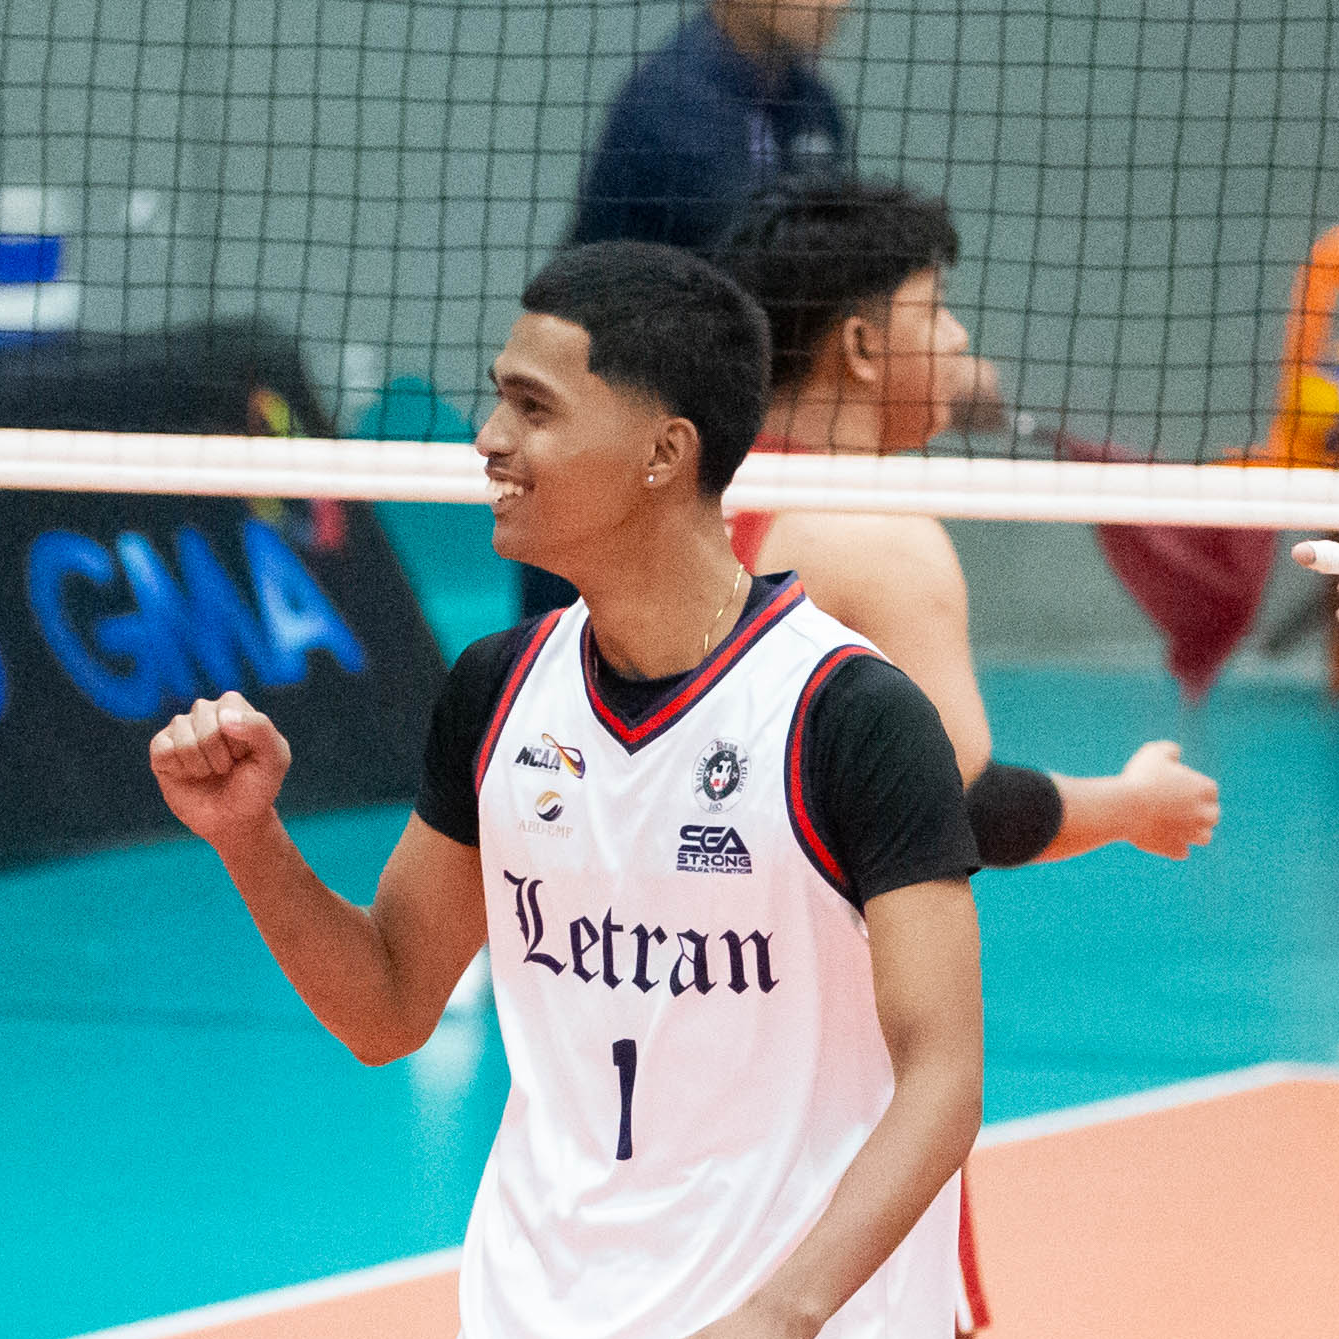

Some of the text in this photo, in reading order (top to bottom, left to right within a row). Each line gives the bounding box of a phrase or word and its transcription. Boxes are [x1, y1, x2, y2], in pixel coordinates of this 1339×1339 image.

[26, 518, 367, 722] GMA
[515, 745, 561, 771] NCAA
[677, 852, 752, 867] STRONG
[503, 870, 780, 997] Letran
[612, 1038, 637, 1161] 1
